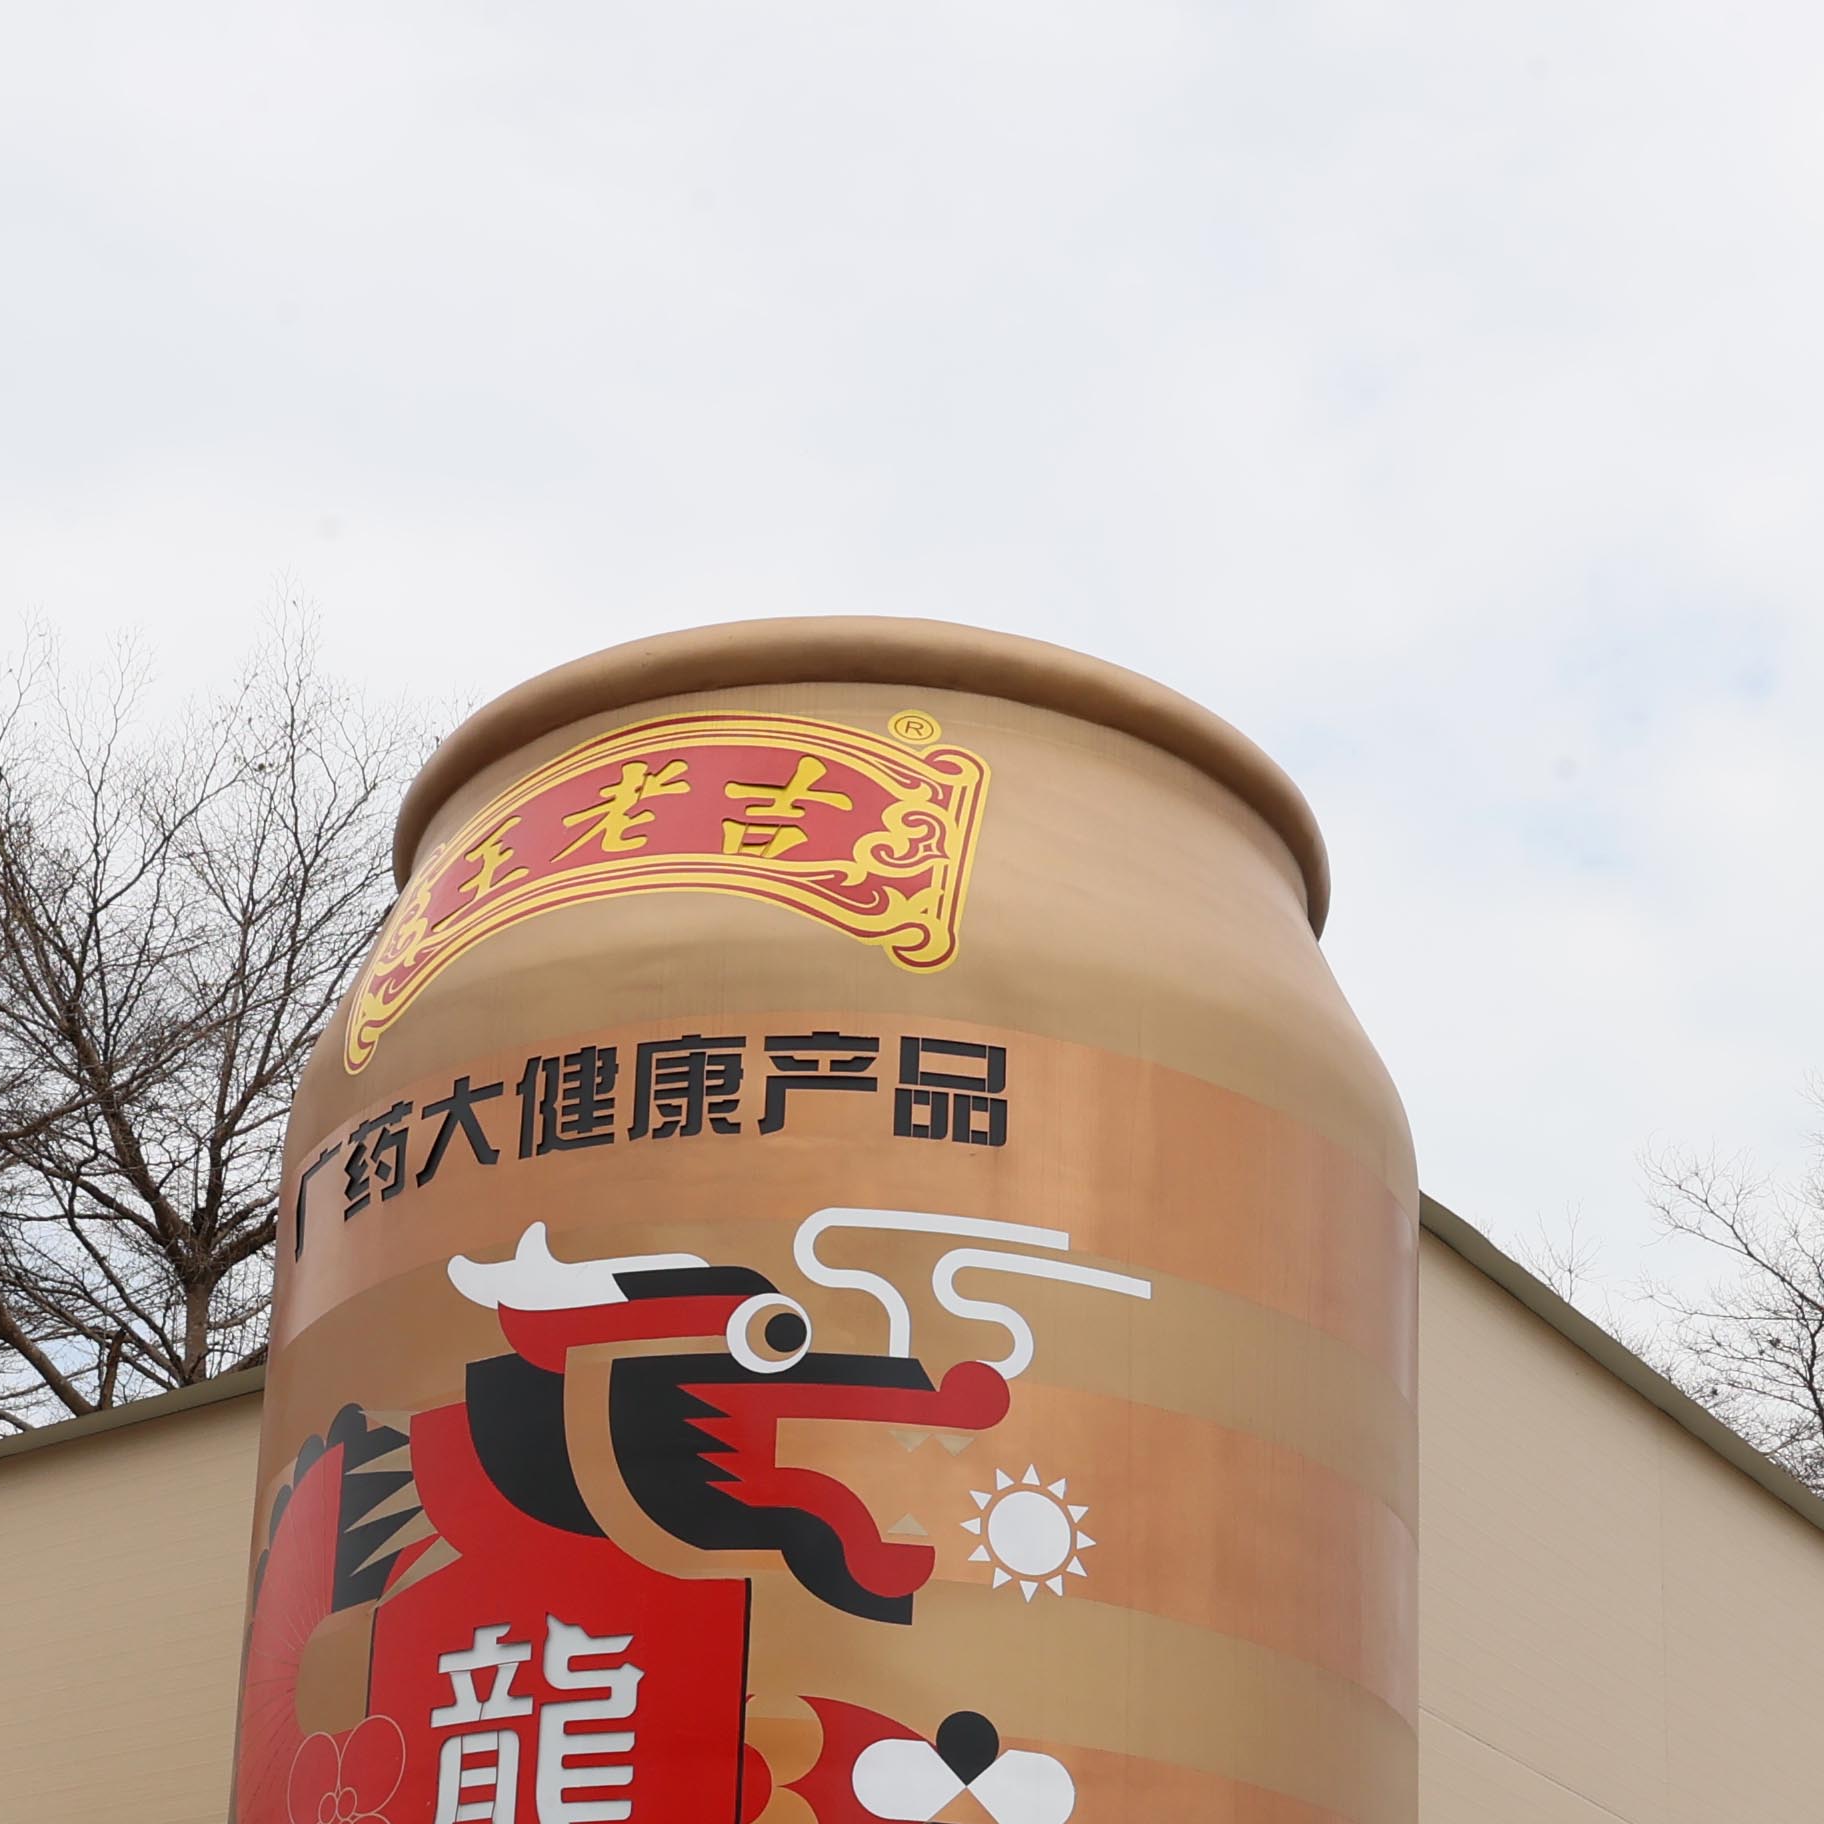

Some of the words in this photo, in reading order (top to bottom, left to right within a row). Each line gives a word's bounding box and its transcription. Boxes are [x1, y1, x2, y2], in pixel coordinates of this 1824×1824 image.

[455, 752, 858, 898] 王老吉
[293, 1031, 1010, 1263] 广药大健康产品
